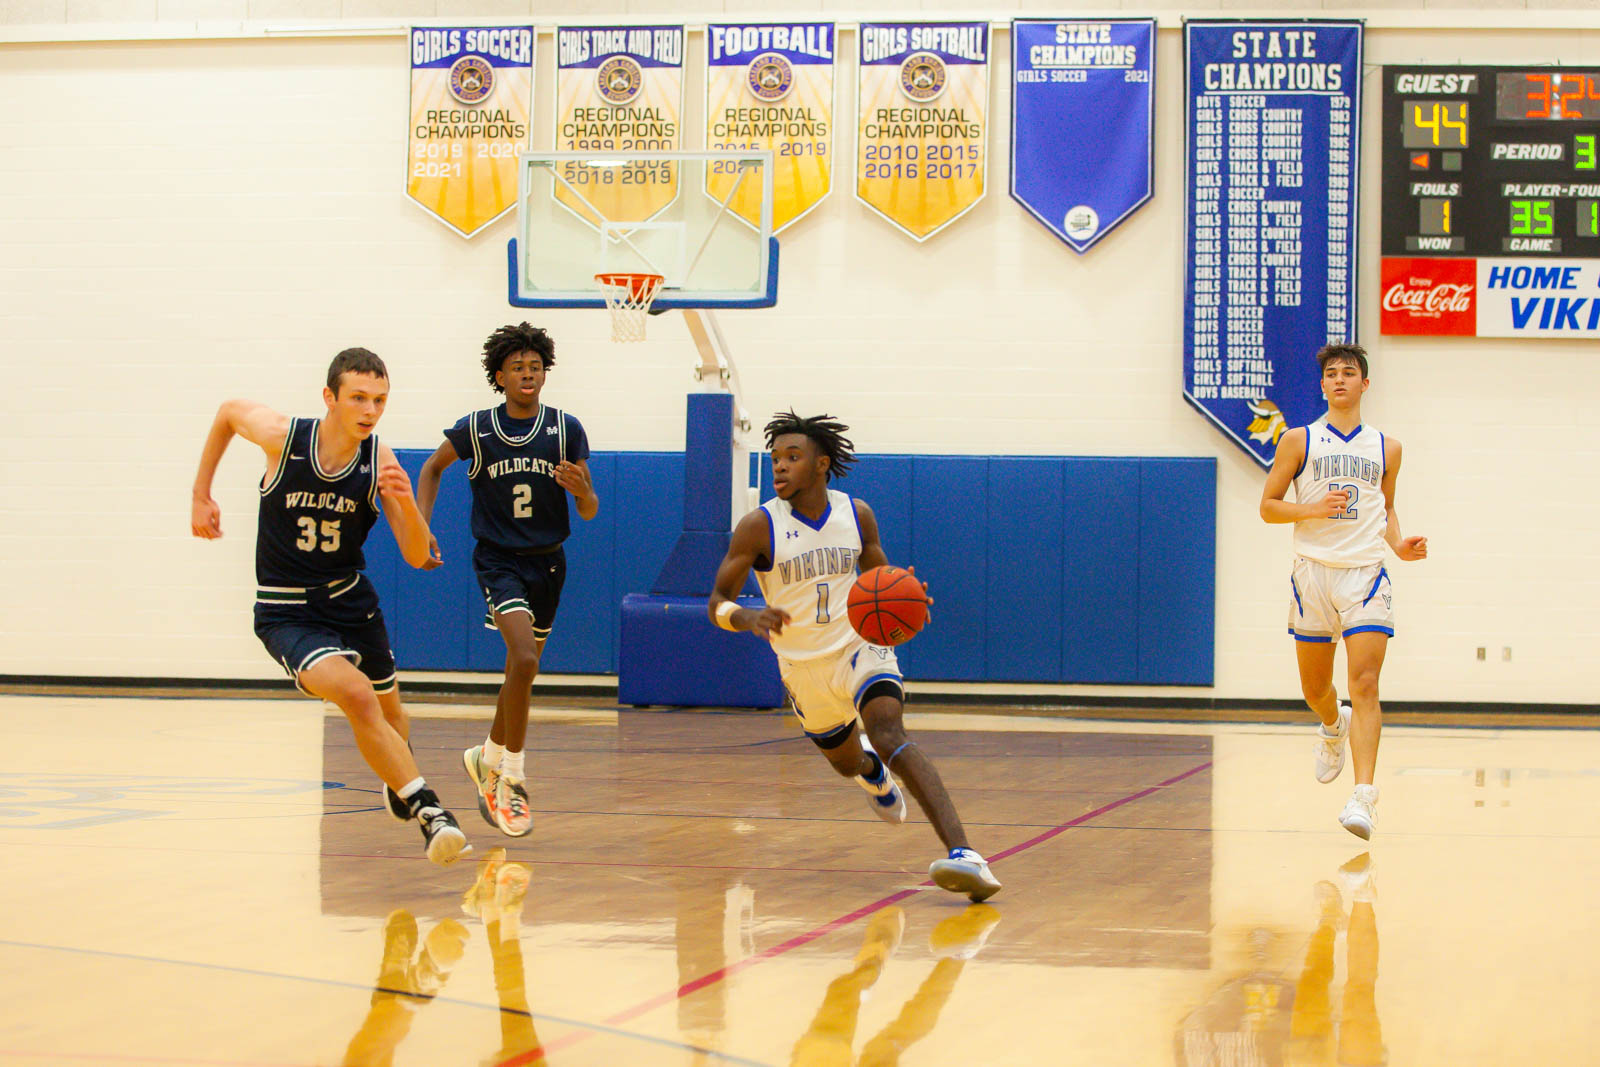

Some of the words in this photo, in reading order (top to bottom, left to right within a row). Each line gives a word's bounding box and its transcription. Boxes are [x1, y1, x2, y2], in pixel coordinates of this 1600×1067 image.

[1055, 24, 1112, 44] STATE
[413, 30, 461, 66] GIRLS
[466, 30, 532, 64] SOCCER
[559, 30, 590, 66] GIRLS
[592, 30, 626, 57] TRACK
[628, 29, 652, 58] AND
[654, 30, 683, 65] FIELD
[712, 26, 832, 60] FOOTBALL
[862, 26, 907, 62] GIRLS
[911, 27, 985, 61] SOFTBALL
[1232, 31, 1317, 58] STATE
[1030, 45, 1137, 65] CHAMPIONS
[1017, 70, 1047, 82] GIRLS
[1051, 70, 1087, 82] SOCCER
[1124, 70, 1149, 82] 2021
[1205, 63, 1342, 90] CHAMPIONS
[1397, 74, 1476, 93] GUEST
[1197, 96, 1221, 107] BOYS
[1230, 96, 1266, 107] SOCCER
[427, 109, 516, 123] REGIONAL
[574, 107, 665, 122] REGIONAL
[725, 107, 817, 122] REGIONAL
[877, 108, 970, 123] REGIONAL
[1197, 109, 1222, 120] GIRLS
[1230, 109, 1258, 120] CROSS
[1262, 109, 1302, 120] COUNTRY
[563, 123, 675, 137] CHAMPIONS
[713, 123, 827, 137] CHAMPIONS
[1197, 122, 1222, 134] GIRLS
[1229, 122, 1258, 133] CROSS
[1262, 122, 1302, 133] COUNTRY
[1414, 103, 1467, 145] 44
[415, 124, 525, 139] CHAMPIONS
[865, 124, 980, 139] CHAMPIONS
[567, 140, 614, 150] 1999
[622, 140, 672, 150] 2000
[1197, 135, 1222, 147] GIRLS
[1229, 135, 1258, 146] CROSS
[1262, 135, 1302, 147] COUNTRY
[415, 144, 463, 158] 2019
[477, 143, 526, 158] 2020
[780, 142, 826, 156] 2019
[865, 145, 918, 160] 2010
[926, 145, 979, 160] 2015
[1197, 149, 1222, 160] GIRLS
[1229, 148, 1258, 160] CROSS
[1262, 148, 1302, 160] COUNTRY
[1493, 143, 1562, 160] PERIOD
[1575, 135, 1596, 169] 3
[413, 162, 461, 177] 2021
[865, 163, 918, 179] 2016
[926, 163, 977, 179] 2017
[1197, 162, 1219, 173] BOYS
[1230, 161, 1258, 173] TRACK
[1277, 162, 1302, 173] FIELD
[565, 170, 613, 184] 2018
[621, 169, 671, 184] 2019
[1197, 175, 1222, 186] GIRLS
[1230, 174, 1258, 186] TRACK
[1276, 175, 1302, 186] FIELD
[1196, 188, 1220, 199] BOYS
[1229, 188, 1265, 199] SOCCER
[1412, 183, 1459, 195] FOULS
[1196, 201, 1218, 212] BOYS
[1228, 201, 1257, 212] CROSS
[1262, 201, 1301, 212] COUNTRY
[1196, 215, 1221, 226] GIRLS
[1229, 214, 1257, 226] TRACK
[1276, 214, 1302, 226] FIELD
[1442, 200, 1450, 233] 1
[1511, 201, 1553, 235] 35
[1591, 202, 1598, 235] 1
[1196, 228, 1221, 239] GIRLS
[1228, 227, 1256, 239] CROSS
[1261, 228, 1301, 239] COUNTRY
[1196, 241, 1221, 252] GIRLS
[1229, 240, 1257, 252] TRACK
[1276, 241, 1302, 252] FIELD
[1418, 237, 1452, 250] WON
[1510, 238, 1553, 250] GAME
[1196, 254, 1221, 265] GIRLS
[1228, 254, 1257, 265] CROSS
[1261, 254, 1301, 265] COUNTRY
[1196, 267, 1221, 278] GIRLS
[1229, 267, 1257, 278] TRACK
[1276, 267, 1301, 279] FIELD
[1488, 266, 1582, 289] HOME
[1195, 280, 1220, 292] GIRLS
[1229, 280, 1256, 291] TRACK
[1275, 281, 1301, 292] FIELD
[1195, 294, 1220, 305] GIRLS
[1229, 293, 1256, 305] TRACK
[1275, 294, 1301, 305] FIELD
[1383, 283, 1474, 312] Coca-Cola
[1195, 307, 1218, 318] BOYS
[1228, 307, 1264, 318] SOCCER
[1195, 320, 1218, 331] BOYS
[1228, 320, 1263, 331] SOCCER
[1195, 334, 1218, 345] BOYS
[1228, 333, 1263, 345] SOCCER
[1195, 347, 1219, 358] BOYS
[1228, 347, 1264, 358] SOCCER
[1194, 360, 1221, 371] GIRLS
[1227, 360, 1272, 371] SOFTBALL
[1194, 373, 1221, 384] GIRLS
[1227, 374, 1271, 385] SOFTBALL
[1194, 387, 1219, 398] BOYS
[1221, 387, 1264, 398] BASEBALL
[487, 457, 555, 480] WILDCATS
[1312, 455, 1380, 487] VIKINGS
[285, 491, 358, 513] WILDCATS
[512, 484, 532, 519] 2
[296, 516, 341, 553] 35
[816, 583, 830, 624] 1
